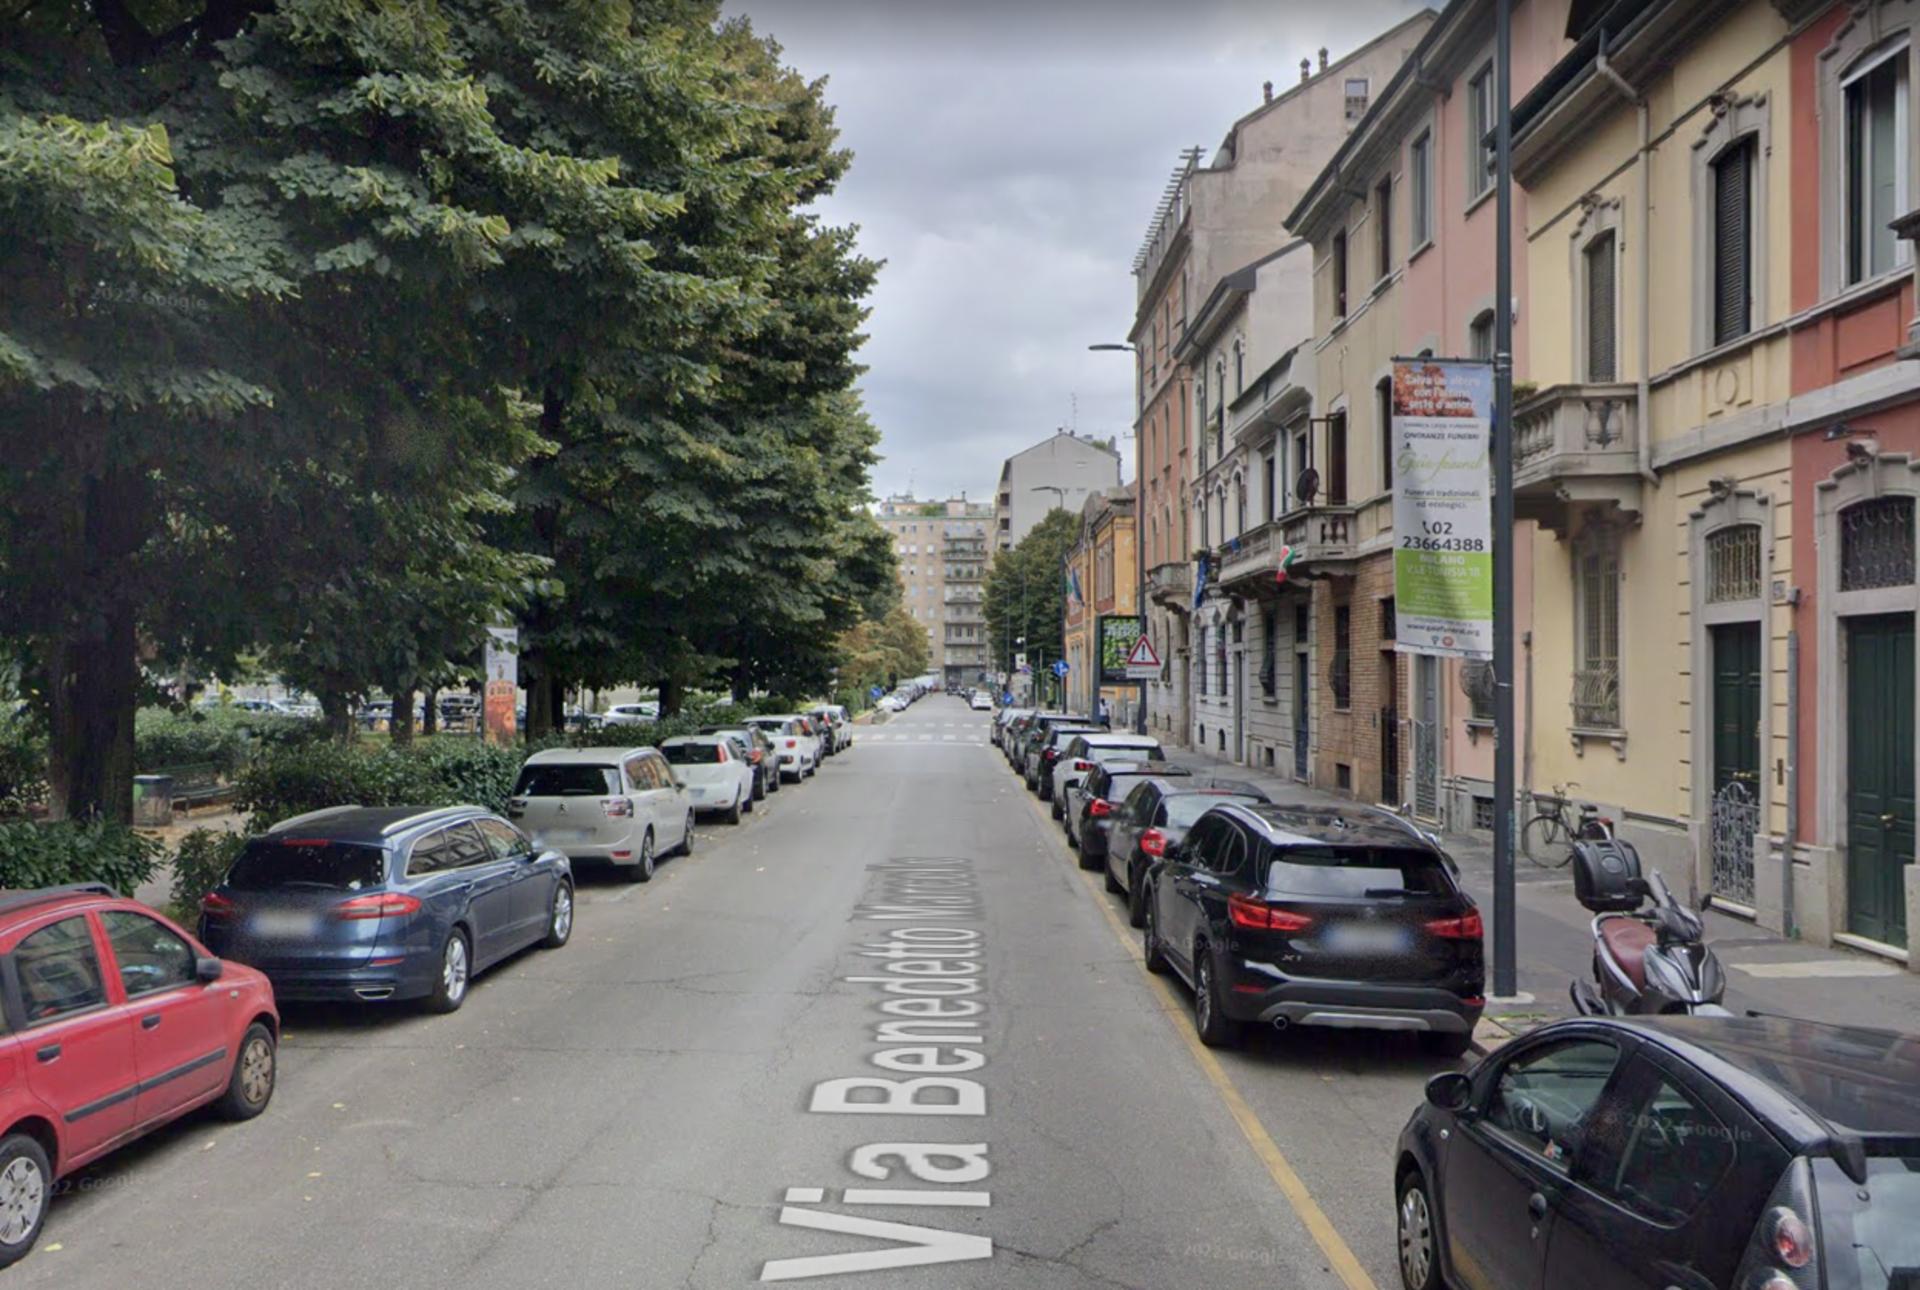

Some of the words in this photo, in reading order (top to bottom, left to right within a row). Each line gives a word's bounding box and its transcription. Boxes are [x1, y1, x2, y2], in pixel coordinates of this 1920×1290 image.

[1432, 521, 1453, 535] 02
[1402, 536, 1484, 551] 23664388
[1419, 554, 1465, 565] MILANO
[809, 927, 986, 1116] Benedetto
[760, 1143, 993, 1282] Via
